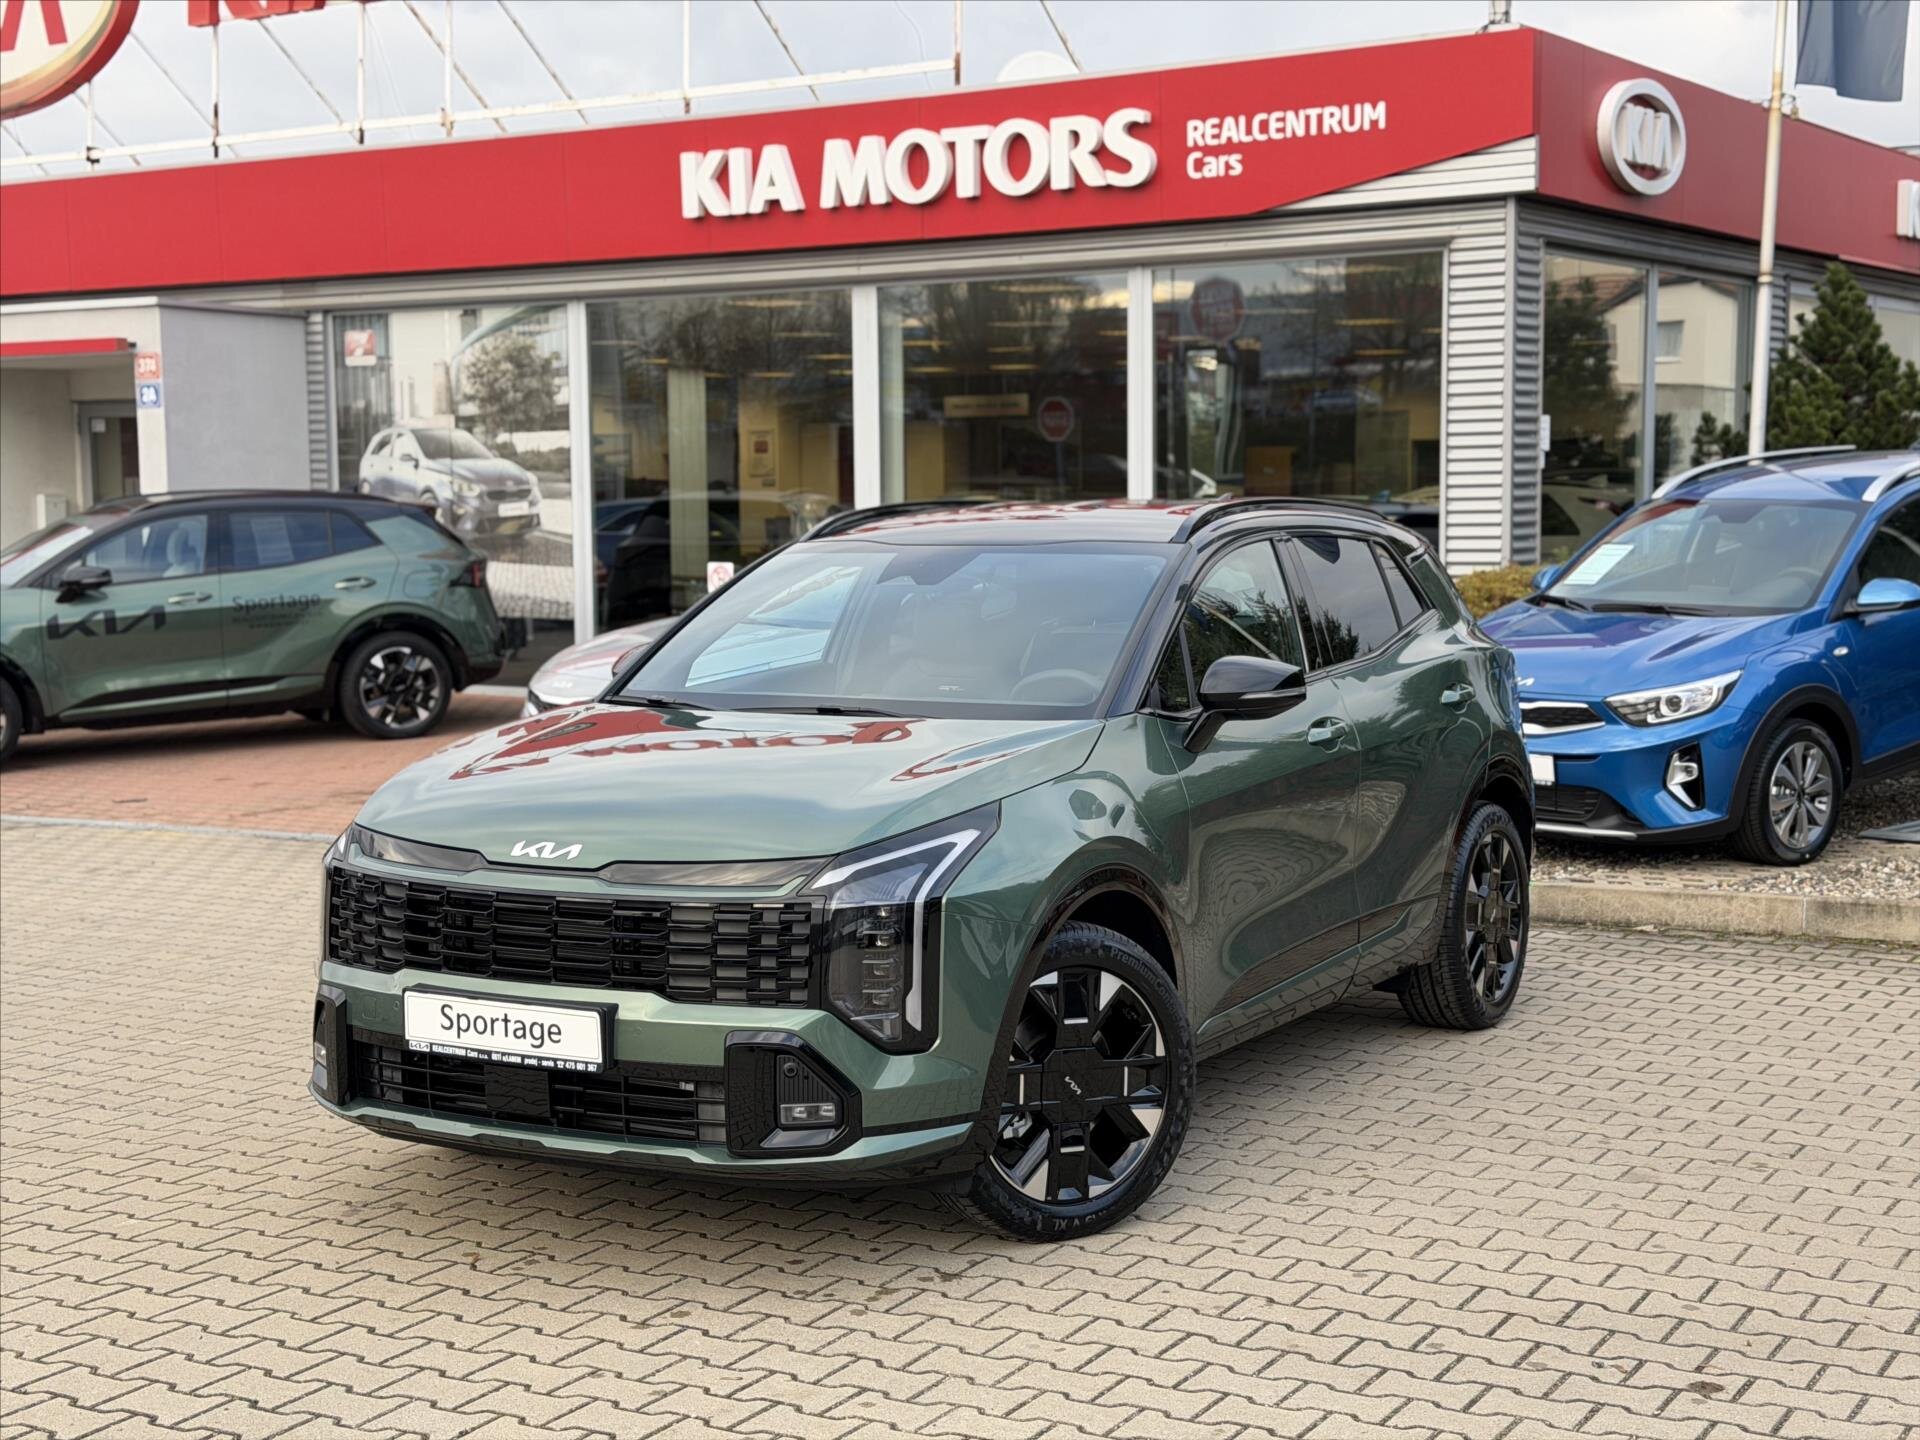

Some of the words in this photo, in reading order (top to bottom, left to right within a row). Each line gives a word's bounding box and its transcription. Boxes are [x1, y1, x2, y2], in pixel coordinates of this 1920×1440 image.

[1186, 101, 1386, 148] REALCENTRUM
[1620, 102, 1672, 169] KIA
[680, 144, 806, 219] KIA
[819, 107, 1157, 209] MOTORS
[1186, 151, 1243, 179] Cars
[232, 594, 321, 615] Sportage
[440, 1003, 562, 1049] Sportage
[432, 1044, 466, 1056] REALCENTRUM
